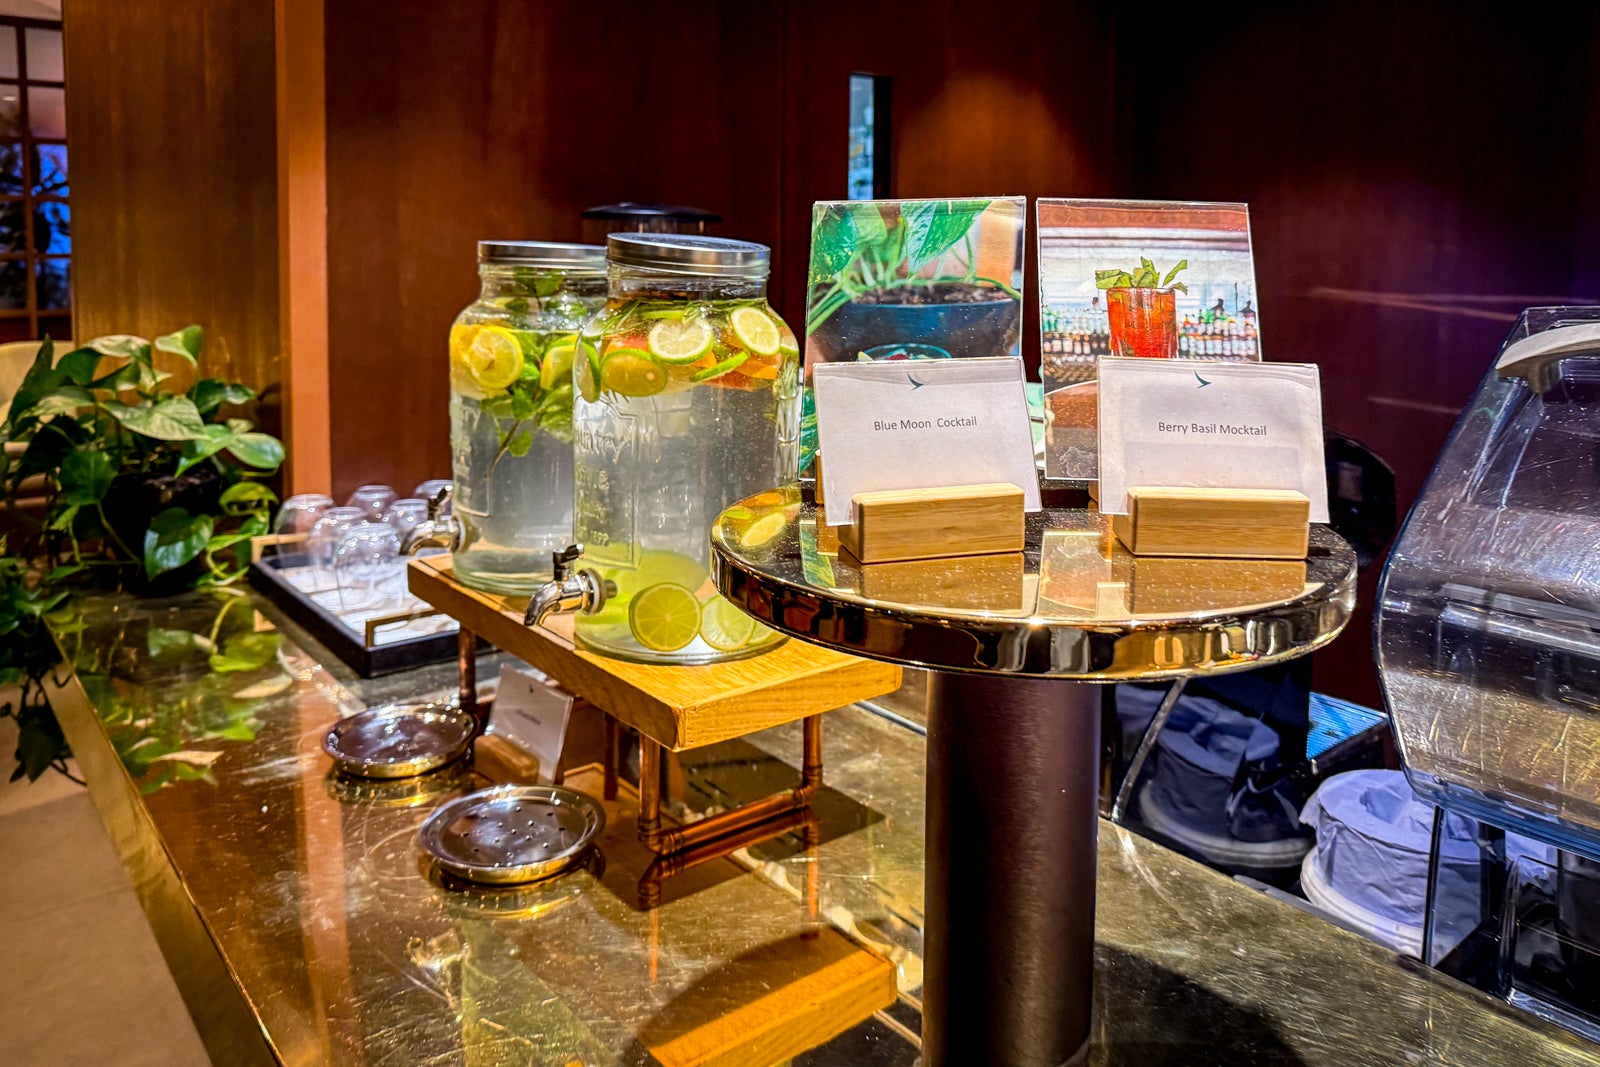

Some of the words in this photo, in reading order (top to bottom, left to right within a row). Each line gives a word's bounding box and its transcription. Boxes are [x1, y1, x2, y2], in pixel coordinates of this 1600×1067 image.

[874, 421, 897, 431] Blue
[900, 420, 932, 429] Moon
[937, 416, 977, 428] Cocktail
[1158, 422, 1188, 434] Berry
[1191, 423, 1216, 433] Basil
[1219, 424, 1267, 435] Mocktail
